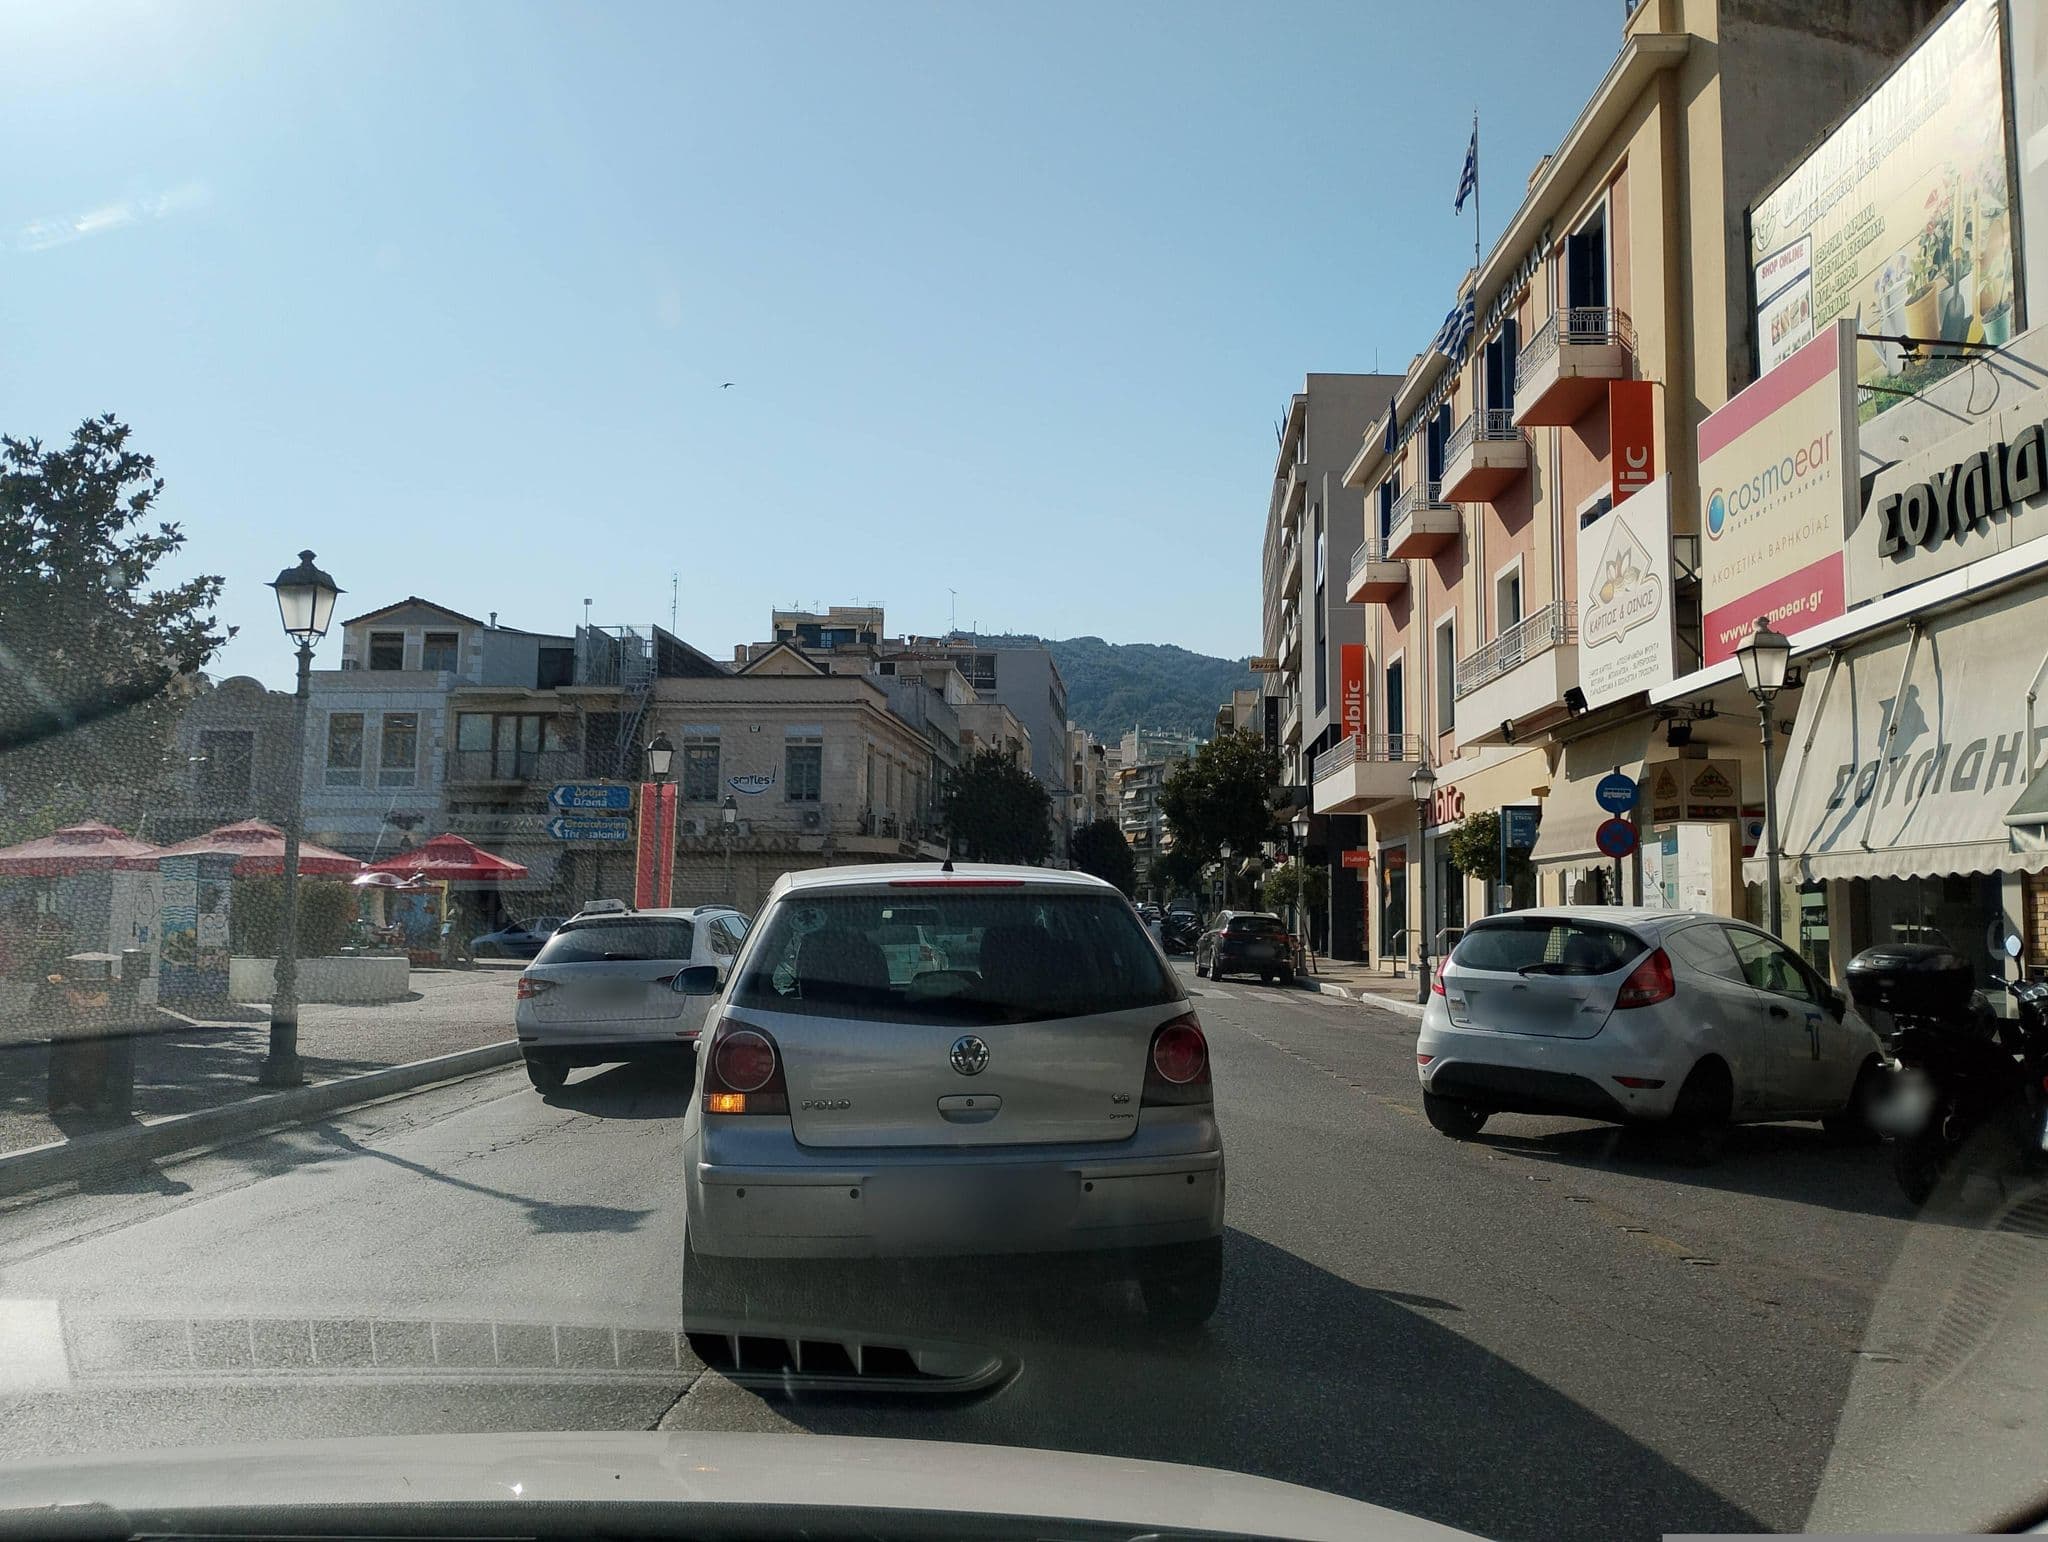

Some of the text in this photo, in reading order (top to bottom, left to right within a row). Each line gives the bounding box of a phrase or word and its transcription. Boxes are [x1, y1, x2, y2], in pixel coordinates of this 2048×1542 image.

[1762, 244, 1804, 279] SHOP ONLINE
[1728, 430, 1834, 516] cosmoear
[1877, 418, 2048, 558] ΣΟΥΛΙΔ
[1711, 549, 1763, 586] ΑΚΟΥΣΤΙΚΑ
[1589, 608, 1617, 635] ΚΑΡΠΟΣ
[1626, 588, 1654, 616] ΟΙΝΟΣ
[1720, 589, 1823, 644] www.cmoear.gr
[573, 798, 608, 807] Drama
[801, 1099, 851, 1111] POLO
